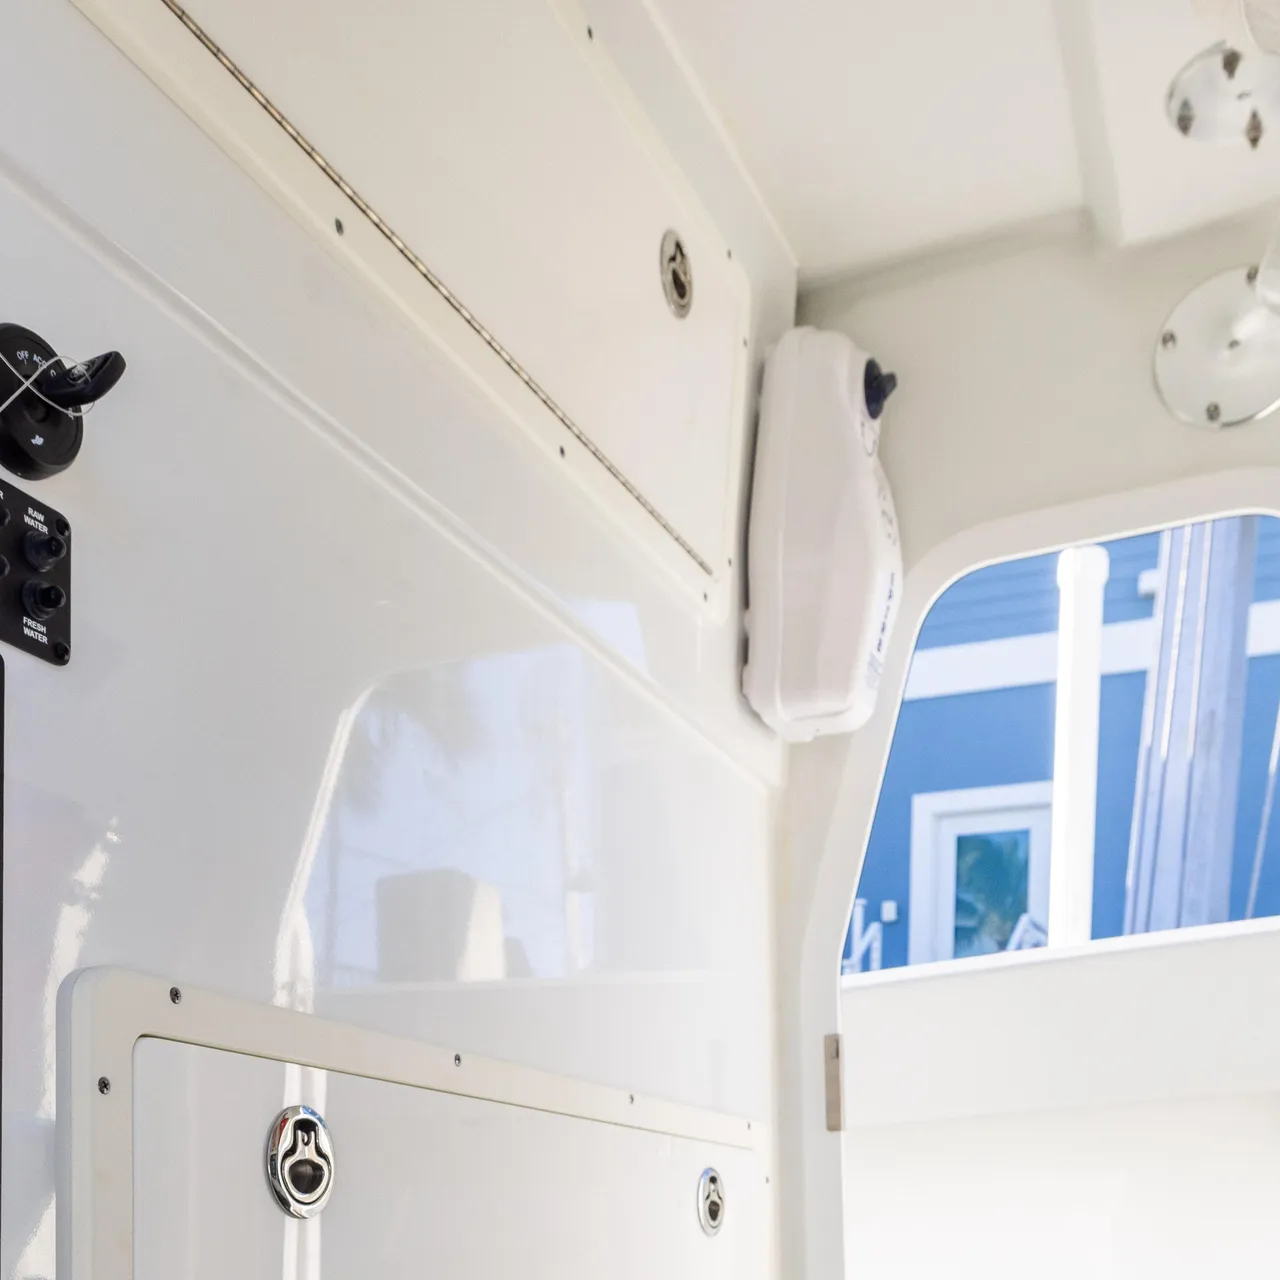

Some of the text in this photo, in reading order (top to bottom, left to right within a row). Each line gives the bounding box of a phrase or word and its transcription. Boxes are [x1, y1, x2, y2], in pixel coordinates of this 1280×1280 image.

[28, 507, 45, 522] RAW
[24, 515, 48, 535] WATER
[23, 616, 47, 634] FRESH
[23, 626, 48, 644] WATER
